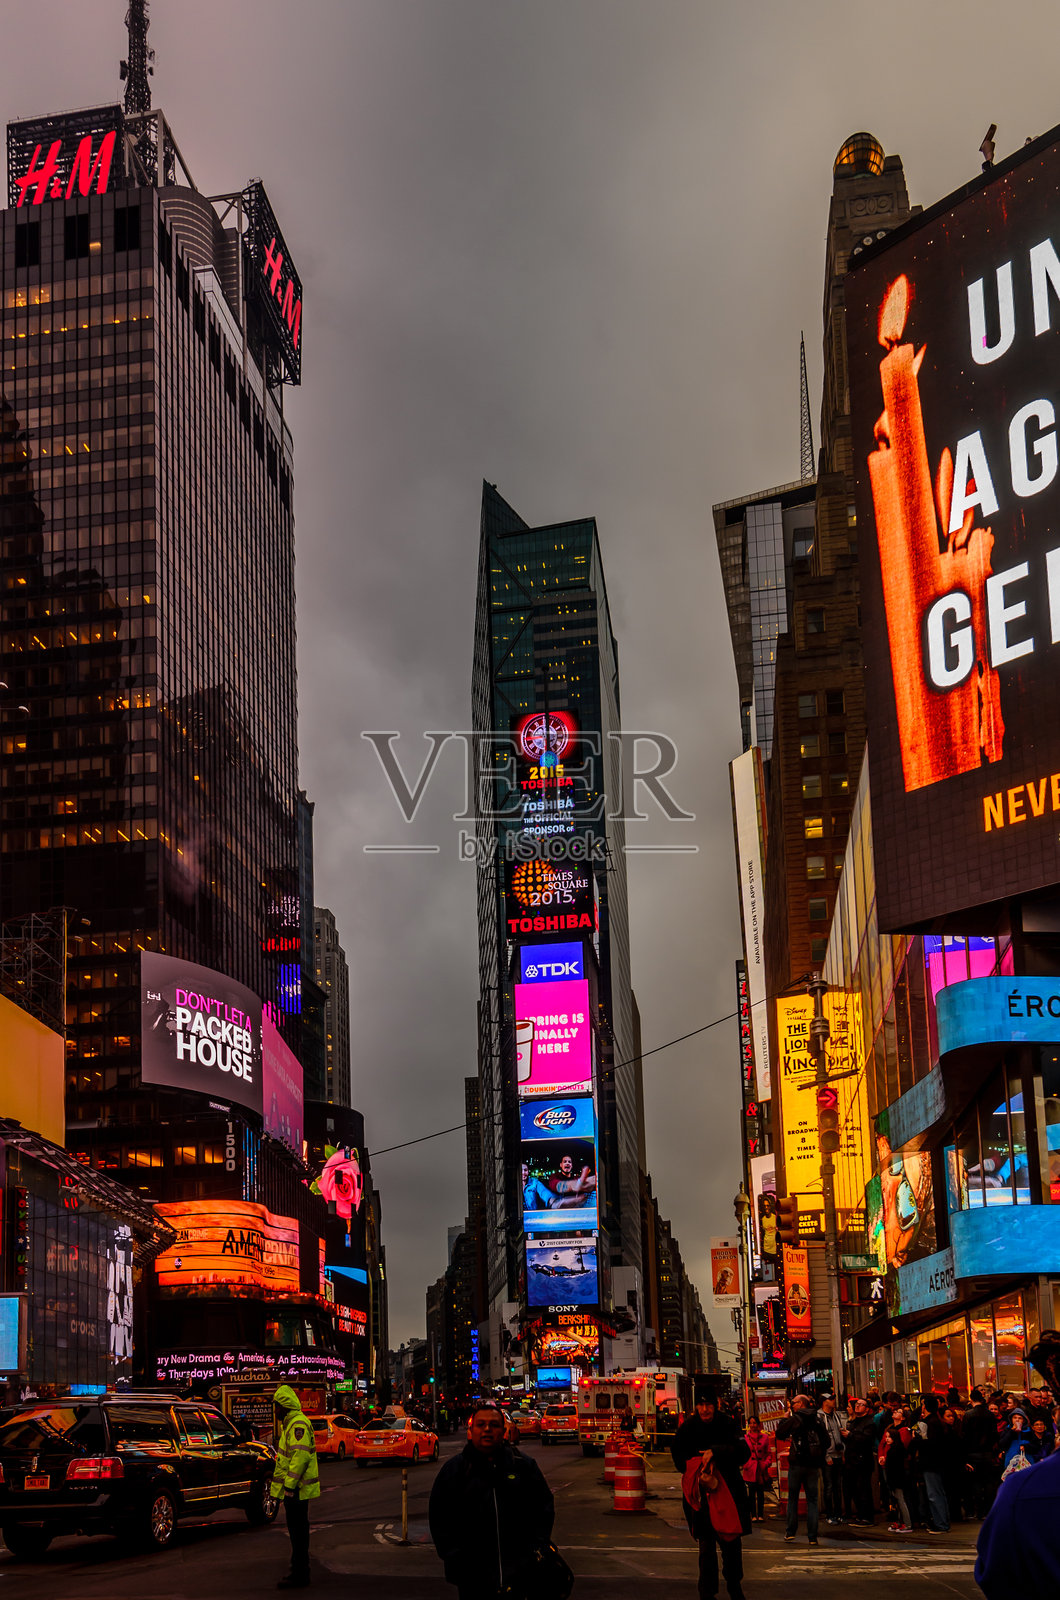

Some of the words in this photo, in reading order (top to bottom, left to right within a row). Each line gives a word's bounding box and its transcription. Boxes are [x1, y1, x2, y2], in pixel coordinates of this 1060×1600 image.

[14, 130, 116, 208] H&M
[263, 237, 302, 350] H&M
[948, 398, 1058, 535] AG
[529, 764, 565, 780] 2015
[520, 777, 574, 790] TOSHIBA
[522, 799, 574, 812] TOSHIBA
[534, 811, 574, 823] OFFICIAL
[523, 824, 566, 836] SPONSOR
[541, 871, 573, 883] TIMES
[747, 859, 755, 883] STORE
[547, 879, 589, 891] SQUARE
[507, 912, 592, 934] TOSHIBA
[751, 914, 758, 926] ON
[752, 926, 761, 965] AVAILABLE
[537, 961, 580, 977] TDK
[175, 988, 224, 1017] DON'T
[224, 1003, 245, 1028] LET
[244, 1015, 253, 1033] A
[572, 1012, 585, 1024] IS
[176, 1006, 253, 1055] PACKED
[786, 1023, 807, 1035] THE
[537, 1042, 570, 1055] HERE
[760, 1035, 769, 1069] REUTERS
[176, 1031, 253, 1084] HOUSE
[545, 1111, 572, 1119] BUD
[540, 1117, 575, 1126] LIGHT
[787, 1127, 818, 1136] BROADWA
[225, 1121, 236, 1172] 1500
[798, 1214, 812, 1222] GET
[188, 1229, 208, 1240] CRIME
[785, 1251, 805, 1263] GUMP
[845, 1256, 853, 1267] W
[856, 1255, 867, 1266] 45
[548, 1305, 579, 1313] SONY
[170, 1355, 187, 1364] New
[188, 1354, 221, 1363] Drama
[278, 1355, 289, 1364] An
[168, 1368, 214, 1380] Thursdays
[229, 1372, 271, 1382] nuchas
[758, 1398, 786, 1415] JERSEY
